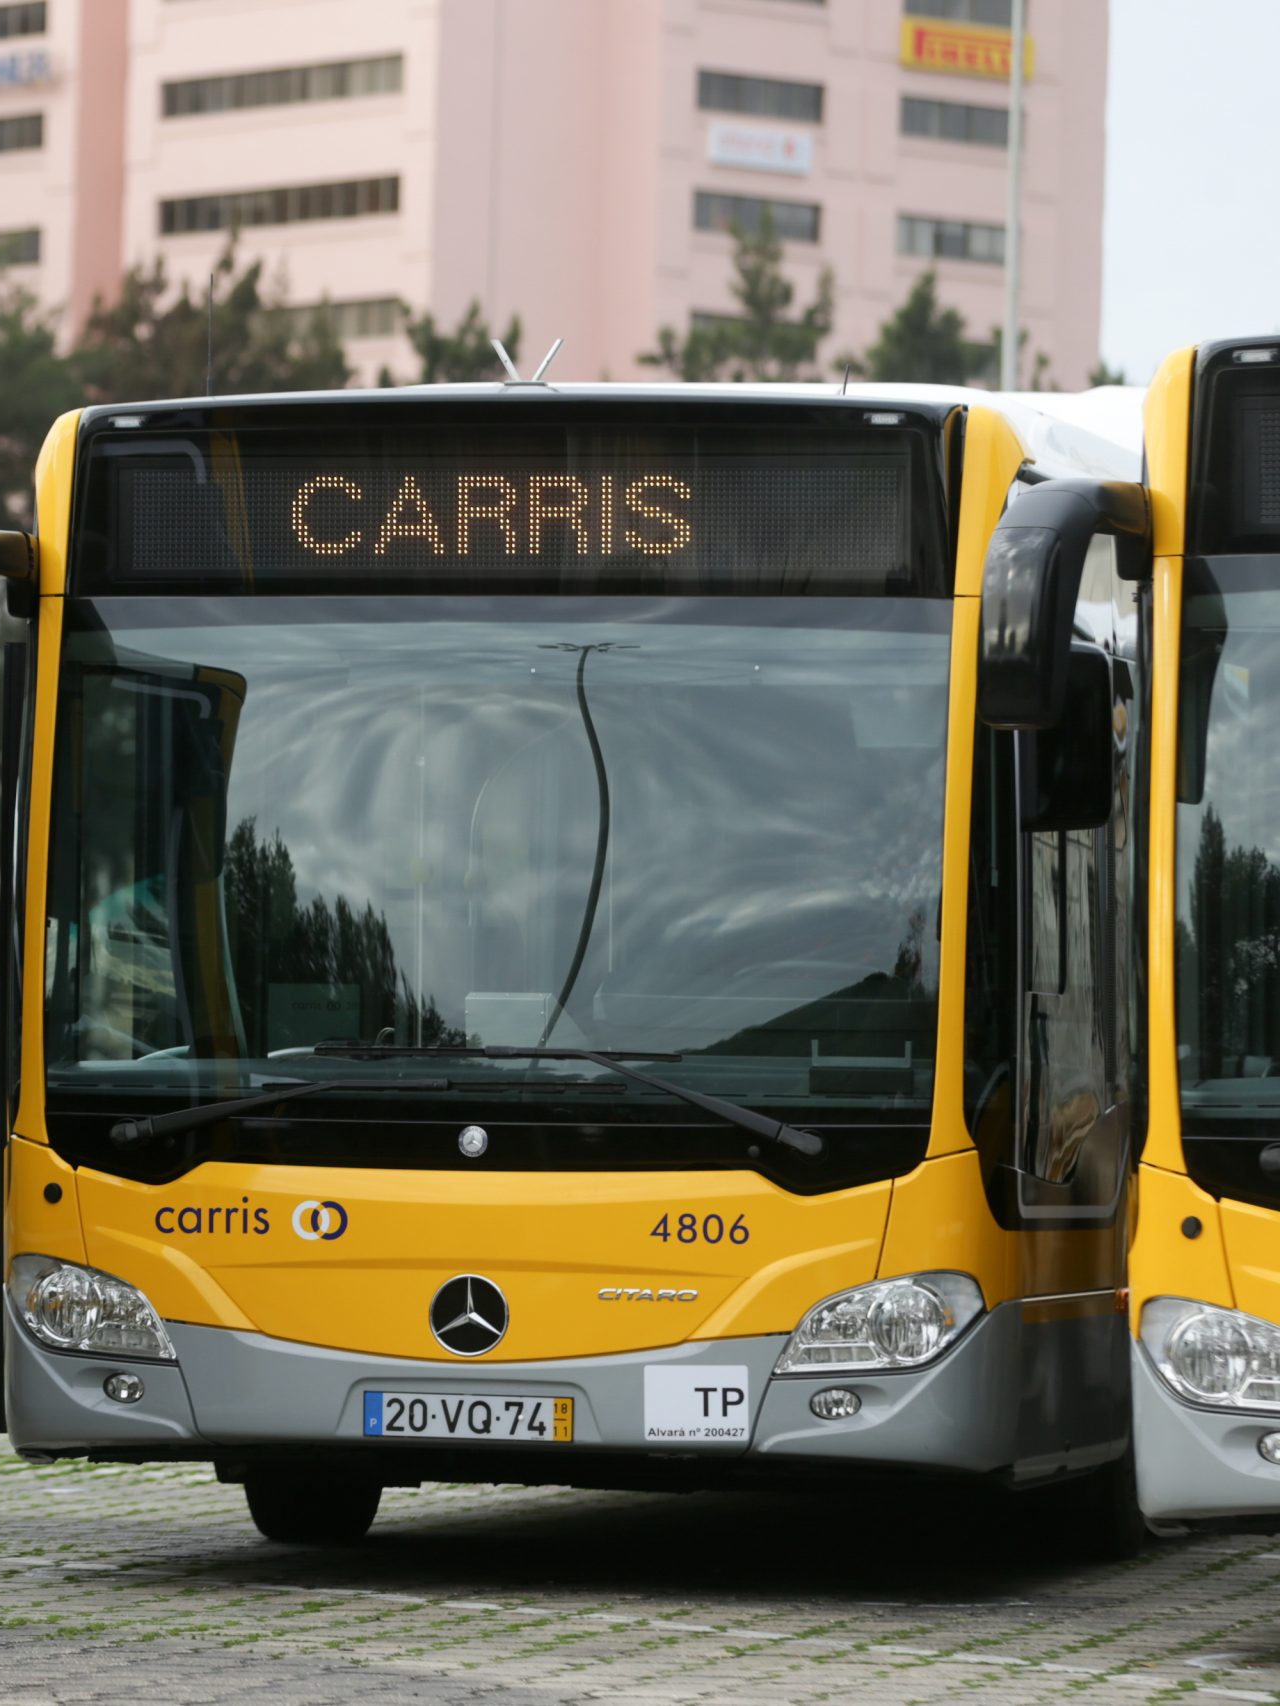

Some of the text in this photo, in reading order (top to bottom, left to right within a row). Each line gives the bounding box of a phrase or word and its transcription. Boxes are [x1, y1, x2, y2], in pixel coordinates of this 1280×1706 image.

[291, 475, 691, 555] CARRIS
[154, 1196, 270, 1235] carris
[649, 1213, 750, 1245] 4806
[597, 1288, 699, 1302] CITARO
[553, 1402, 568, 1414] 18
[694, 1387, 745, 1417] TP
[369, 1417, 378, 1428] P
[648, 1427, 685, 1437] Alvará
[704, 1427, 745, 1437] 200427
